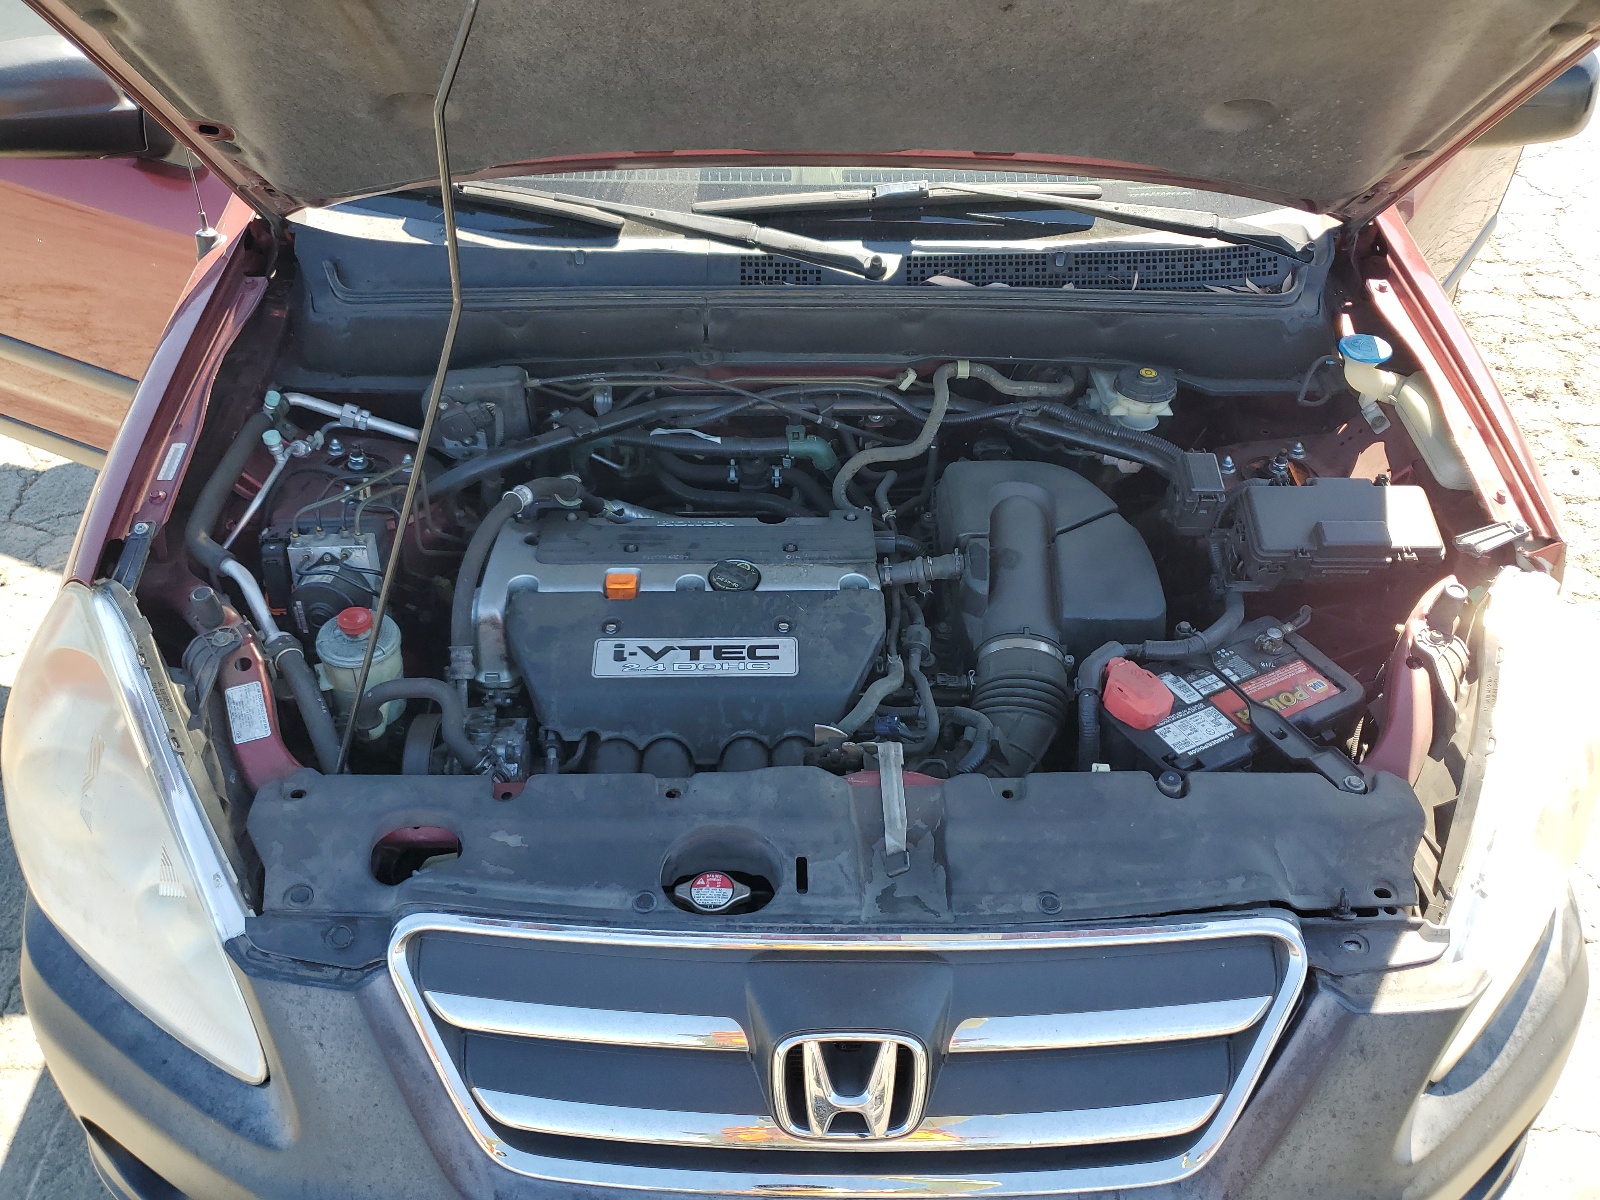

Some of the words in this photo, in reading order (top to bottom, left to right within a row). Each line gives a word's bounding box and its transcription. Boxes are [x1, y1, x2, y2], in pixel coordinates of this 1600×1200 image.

[613, 643, 780, 662] i-VTEC
[621, 662, 667, 672] 2.4
[672, 662, 771, 671] DOHC
